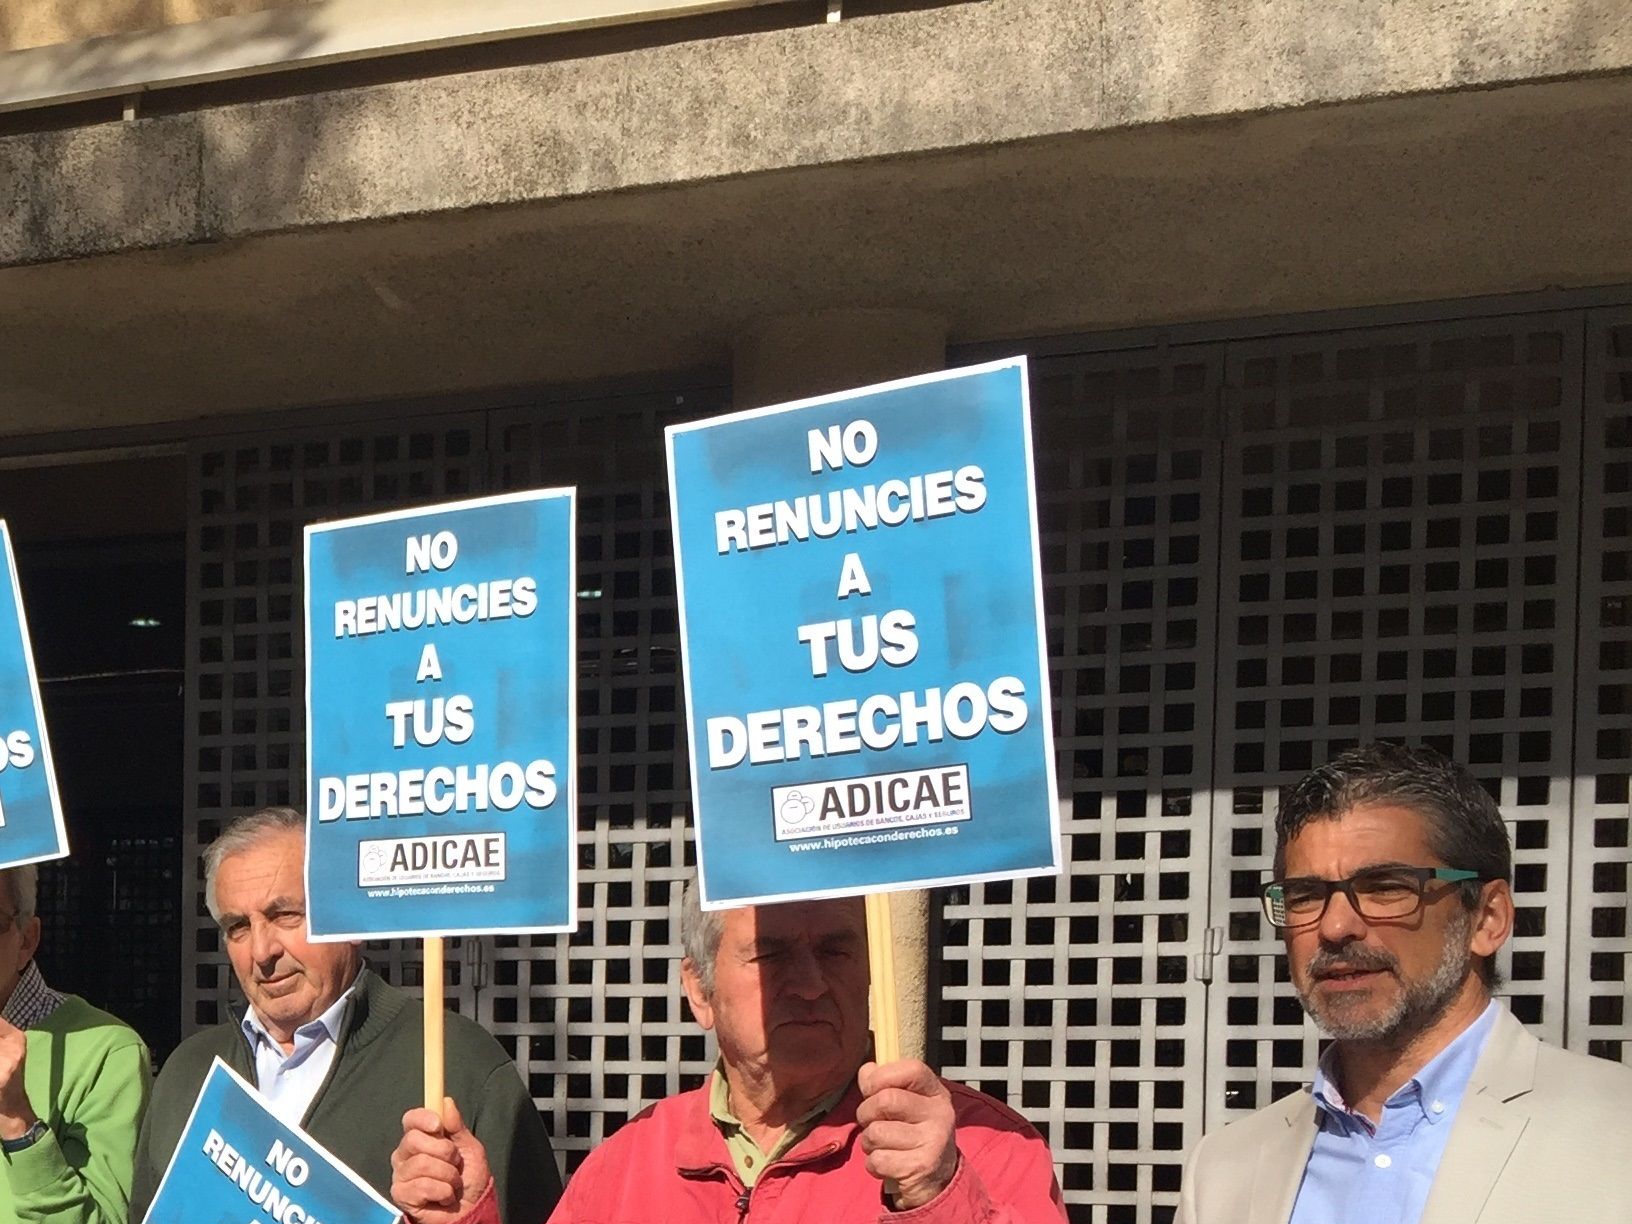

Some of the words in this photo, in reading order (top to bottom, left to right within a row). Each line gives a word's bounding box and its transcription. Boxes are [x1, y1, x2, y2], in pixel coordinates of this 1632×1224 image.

[808, 420, 878, 473] NO
[715, 465, 987, 554] RENUNCIES
[406, 531, 458, 574] NO
[837, 553, 871, 600] A
[335, 577, 537, 638] RENUNCIES
[416, 643, 442, 683] A
[798, 610, 919, 678] TUS
[386, 695, 474, 748] TUS
[707, 676, 1028, 770] DERECHOS
[319, 760, 557, 822] DERECHOS
[819, 771, 963, 821] ADICAE
[390, 838, 499, 872] ADICAE
[789, 825, 958, 852] www.hipotecaconderechos.es
[265, 1139, 309, 1187] NO
